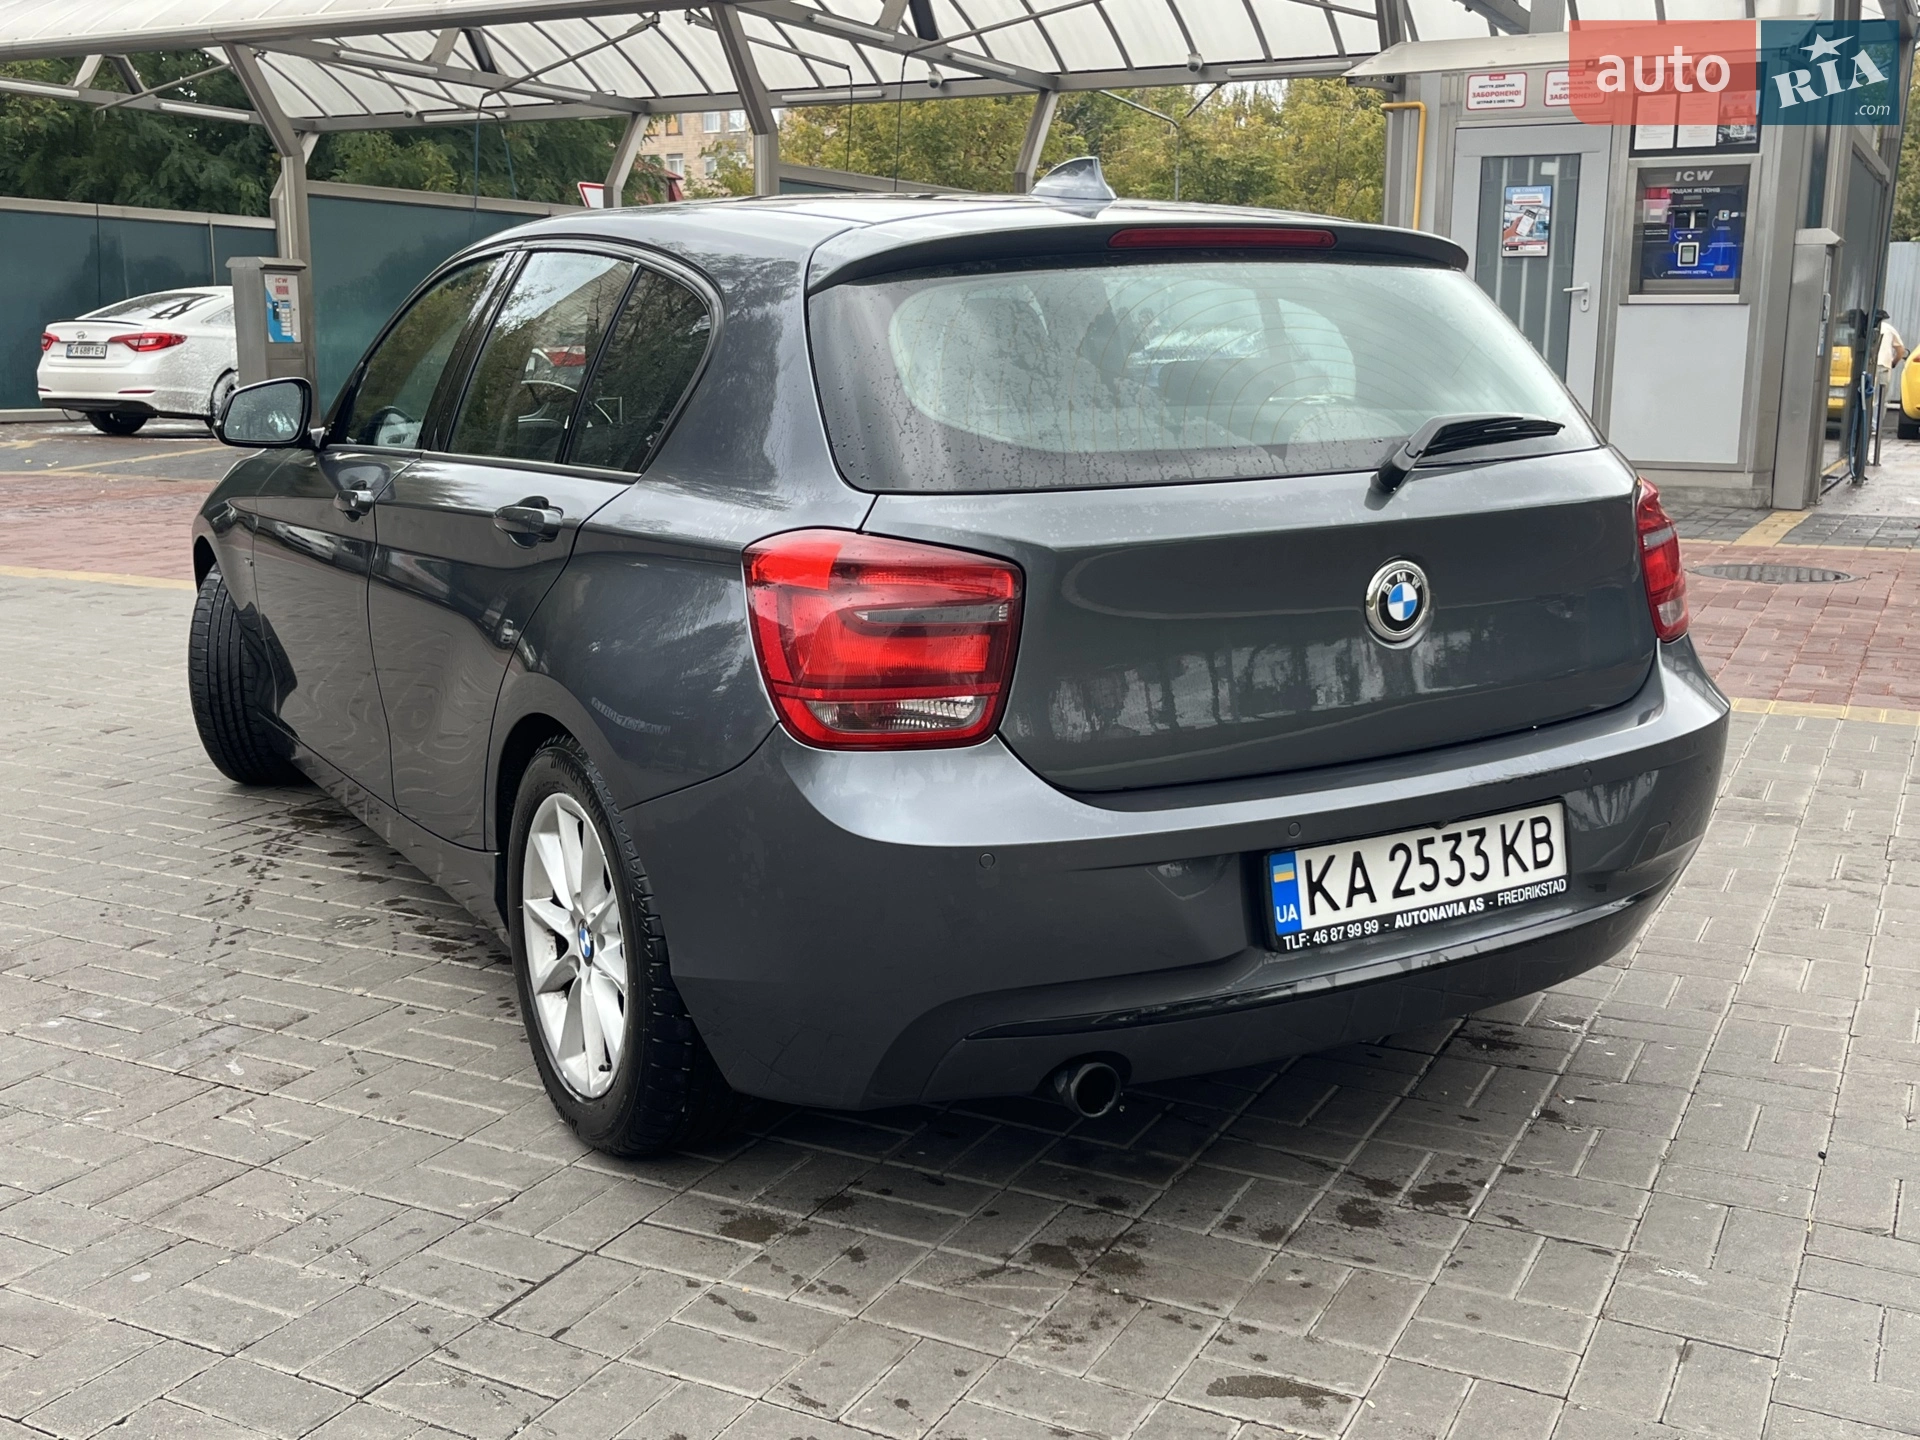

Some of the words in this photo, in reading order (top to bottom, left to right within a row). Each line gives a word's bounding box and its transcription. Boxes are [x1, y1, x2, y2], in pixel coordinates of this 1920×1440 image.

[1472, 90, 1522, 98] ЗАБОРОНЕНО!
[1675, 170, 1713, 182] ICW
[1382, 572, 1421, 596] BMW
[1304, 851, 1377, 916] KA
[1388, 827, 1490, 899] 2533
[1499, 815, 1554, 877] KB
[1276, 904, 1299, 924] UA
[1283, 933, 1311, 950] TLF:
[1312, 930, 1328, 944] 46
[1329, 926, 1345, 941] 87
[1347, 923, 1362, 938] 99
[1364, 919, 1379, 934] 99
[1394, 903, 1467, 929] AUTONAVIA
[1467, 897, 1485, 913] AS
[1497, 878, 1567, 906] FREDRIKSTAD
